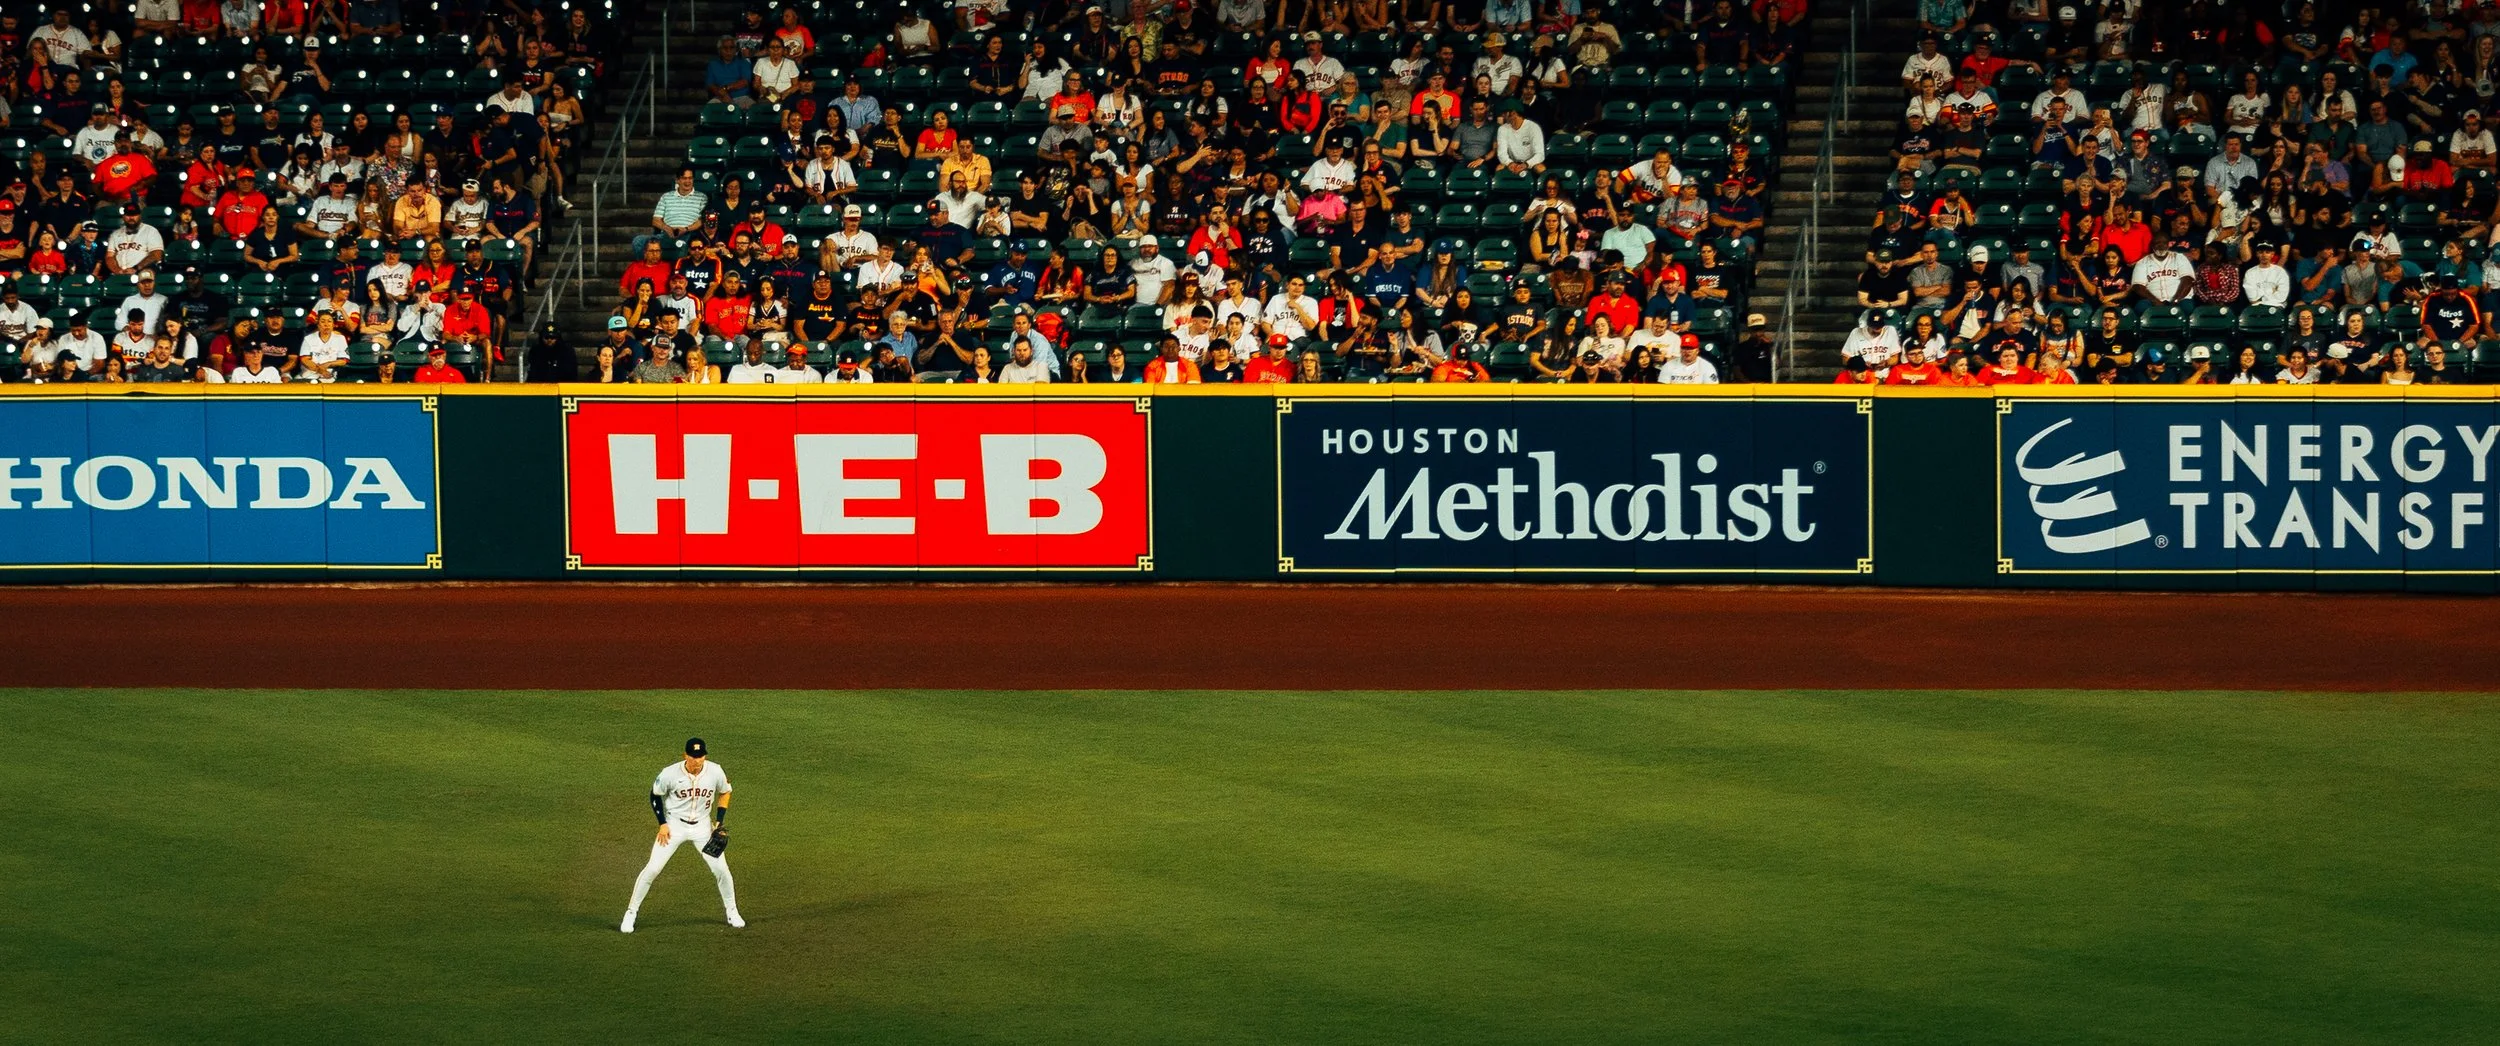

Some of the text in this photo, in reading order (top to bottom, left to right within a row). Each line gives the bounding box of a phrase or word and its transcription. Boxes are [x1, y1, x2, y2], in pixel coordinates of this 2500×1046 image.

[46, 38, 74, 51] STROS
[2134, 95, 2162, 107] STROS
[1324, 176, 1350, 188] TROS
[317, 208, 349, 221] Astros
[839, 245, 866, 256] STROS
[2146, 269, 2177, 282] ASTROS
[2439, 307, 2463, 317] Astros
[1181, 342, 1204, 355] TROS
[1322, 428, 1518, 454] HOUSTON
[2169, 420, 2500, 487] ENERGY
[0, 455, 426, 511] HONDA
[608, 433, 1107, 535] H-E-B
[1323, 451, 1816, 542] Methodist
[2169, 487, 2500, 554] TRANSF
